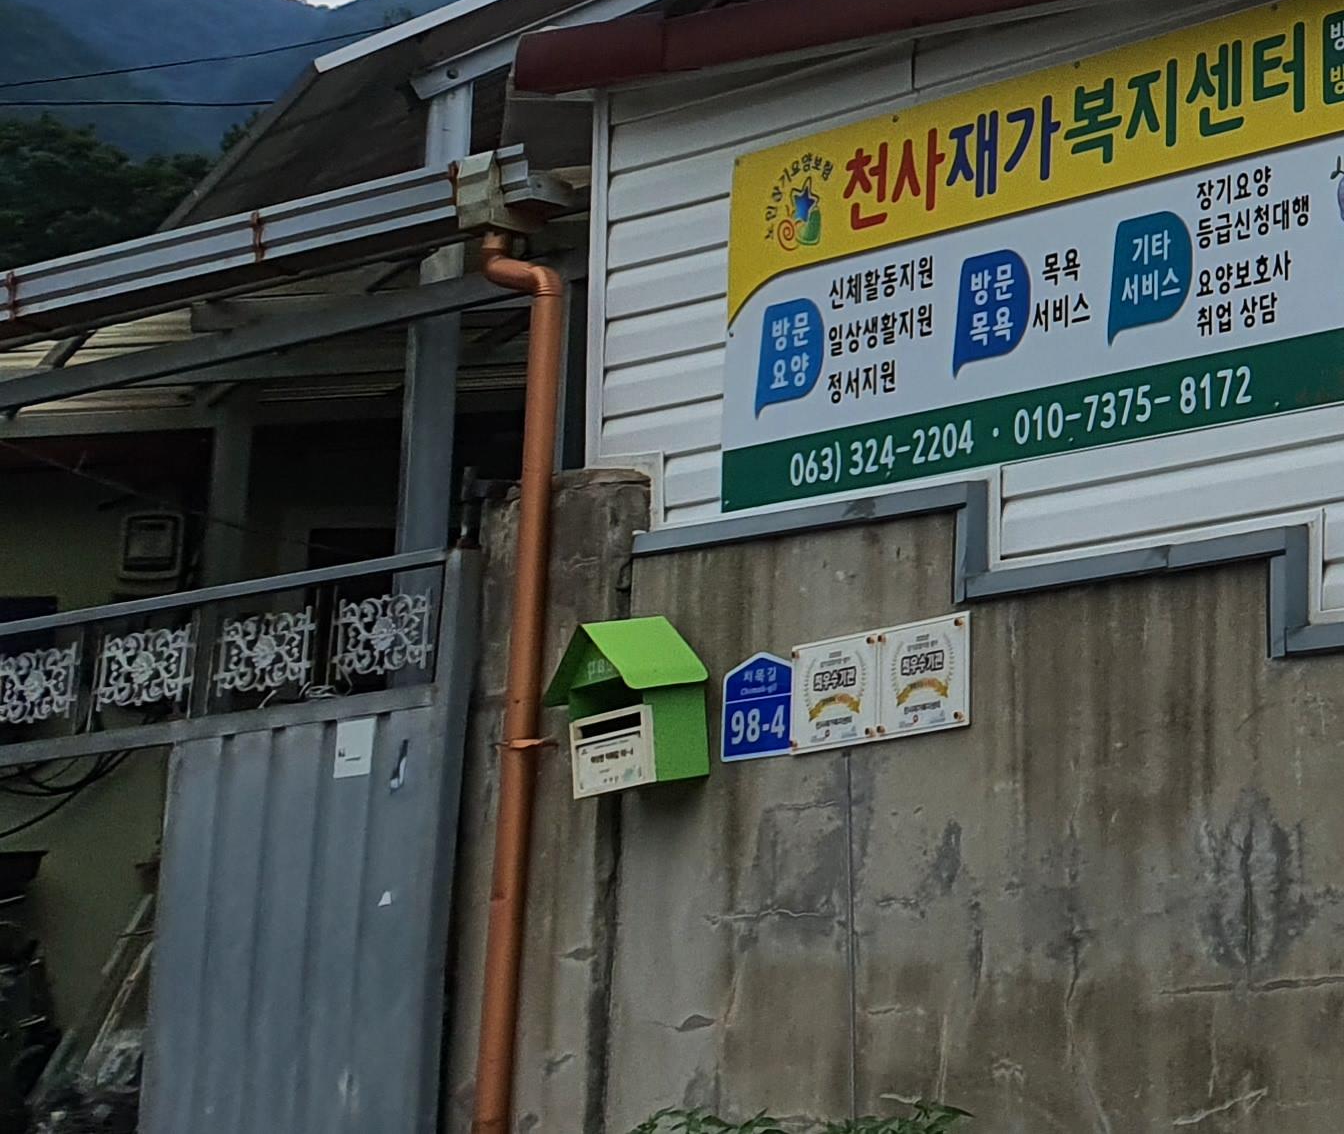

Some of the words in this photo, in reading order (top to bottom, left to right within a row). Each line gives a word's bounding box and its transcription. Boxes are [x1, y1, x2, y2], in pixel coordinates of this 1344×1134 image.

[1196, 165, 1272, 211] 장기요양
[1196, 194, 1310, 249] 등급신청대행
[1042, 248, 1081, 286] 목욕
[1132, 229, 1171, 265] 기타
[828, 255, 935, 310] 신체활동지원
[970, 263, 1015, 305] 방문
[1121, 268, 1182, 305] 서비스
[1196, 250, 1292, 299] 요양보호사
[771, 312, 810, 351] 방문
[828, 303, 934, 357] 일상생활지원
[969, 306, 1015, 346] 목욕
[1032, 292, 1091, 333] 서비스
[1196, 301, 1232, 338] 취업
[1240, 291, 1278, 329] 상담
[769, 352, 810, 390] 요양
[827, 360, 897, 404] 정서지원
[731, 704, 786, 745] 98-4
